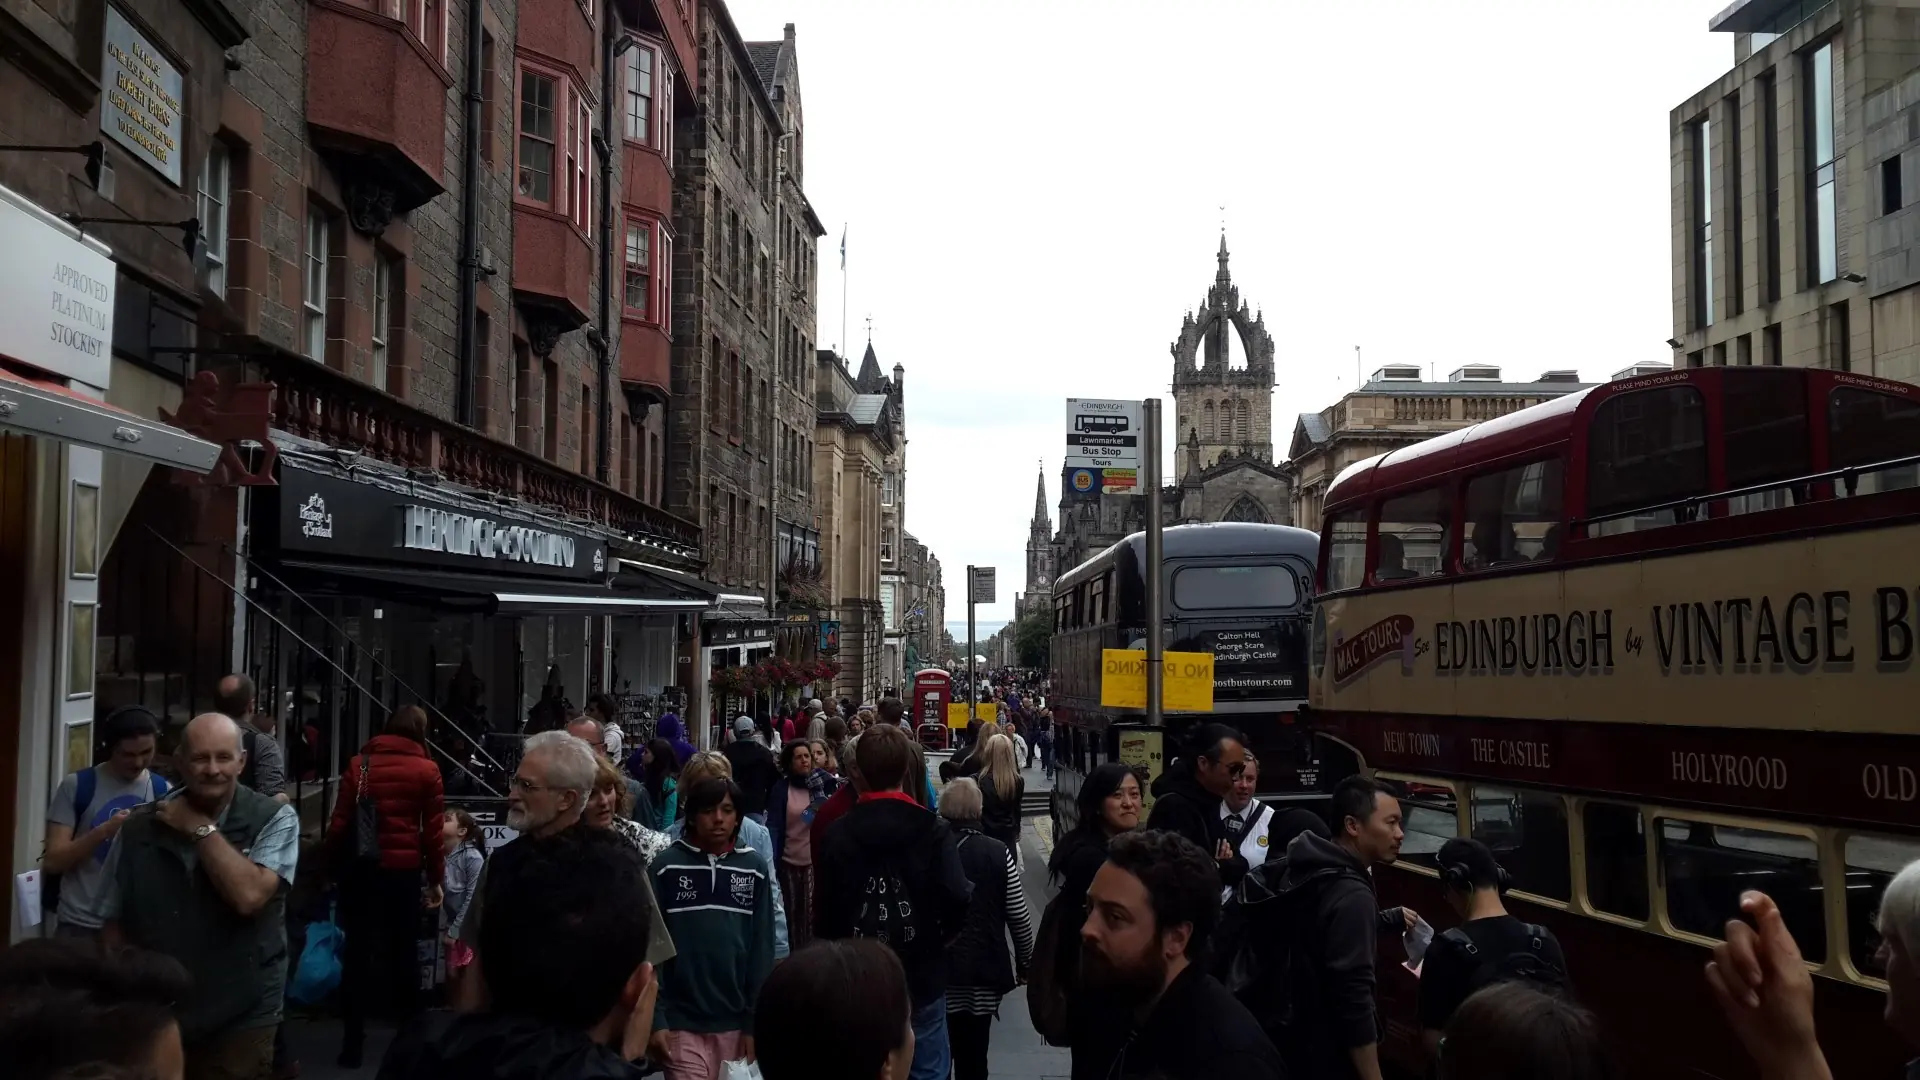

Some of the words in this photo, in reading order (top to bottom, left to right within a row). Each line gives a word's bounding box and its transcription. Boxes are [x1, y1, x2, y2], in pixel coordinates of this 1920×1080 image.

[117, 70, 147, 108] ROBERT
[52, 261, 108, 303] APPROVED
[51, 290, 107, 331] PLATINUM
[50, 321, 103, 358] STOCKIST
[1612, 382, 1635, 392] PLEASE
[1635, 379, 1652, 388] MIND
[1652, 376, 1670, 385] YOUR
[1671, 372, 1689, 381] HEAD
[1834, 374, 1855, 384] PLEASE
[1856, 378, 1873, 387] MIND
[1874, 381, 1891, 391] YOUR
[1890, 385, 1908, 394] HEAD
[1079, 436, 1125, 445] Lawnmarket
[1082, 446, 1099, 455] Bus
[1101, 447, 1122, 458] Stop
[1092, 458, 1112, 467] Tours
[1217, 632, 1243, 641] Calton
[1244, 631, 1262, 640] Hell
[1414, 637, 1430, 657] See
[1436, 609, 1615, 671] EDINBURGH
[1625, 626, 1645, 658] by
[1653, 591, 1855, 669] VINTAGE
[1876, 586, 1920, 663] B
[1215, 642, 1243, 652] George
[1245, 641, 1265, 650] Scare
[1253, 651, 1277, 660] Castle
[1336, 640, 1361, 675] MAC
[1361, 619, 1402, 658] TOURS
[1213, 677, 1292, 688] hostbustours.com
[1383, 730, 1406, 754] NEW
[1408, 732, 1441, 758] TOWN
[1470, 737, 1497, 763] THE
[1499, 740, 1552, 770] CASTLE
[1671, 750, 1788, 791] HOLYROOD
[1861, 763, 1918, 802] OLD
[675, 890, 699, 901] 1995
